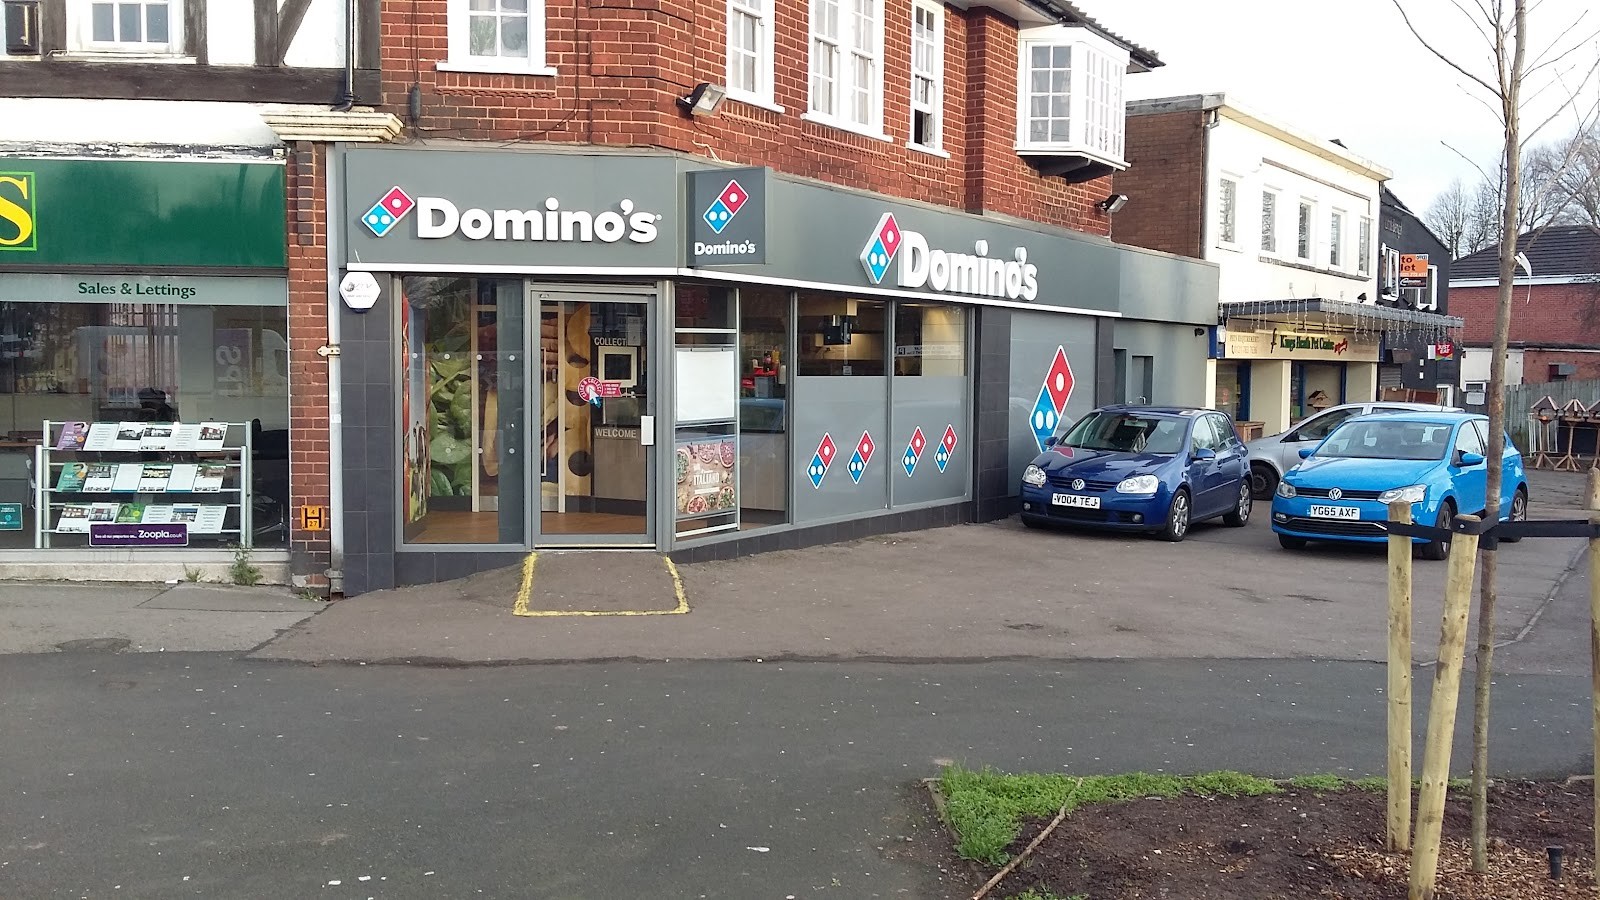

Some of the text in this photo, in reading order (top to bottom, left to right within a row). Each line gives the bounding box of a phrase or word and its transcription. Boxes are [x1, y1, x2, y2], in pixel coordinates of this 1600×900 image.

[417, 197, 658, 243] Domino's
[694, 239, 756, 255] Domino's
[1400, 255, 1413, 263] to
[897, 230, 1038, 301] Domino's
[1400, 263, 1416, 271] let
[78, 282, 196, 299] Sales & Lettings
[594, 336, 627, 346] COLLECT
[595, 428, 637, 438] WELCOME
[1079, 497, 1098, 507] TEJ
[1312, 506, 1357, 517] YG65 AXF
